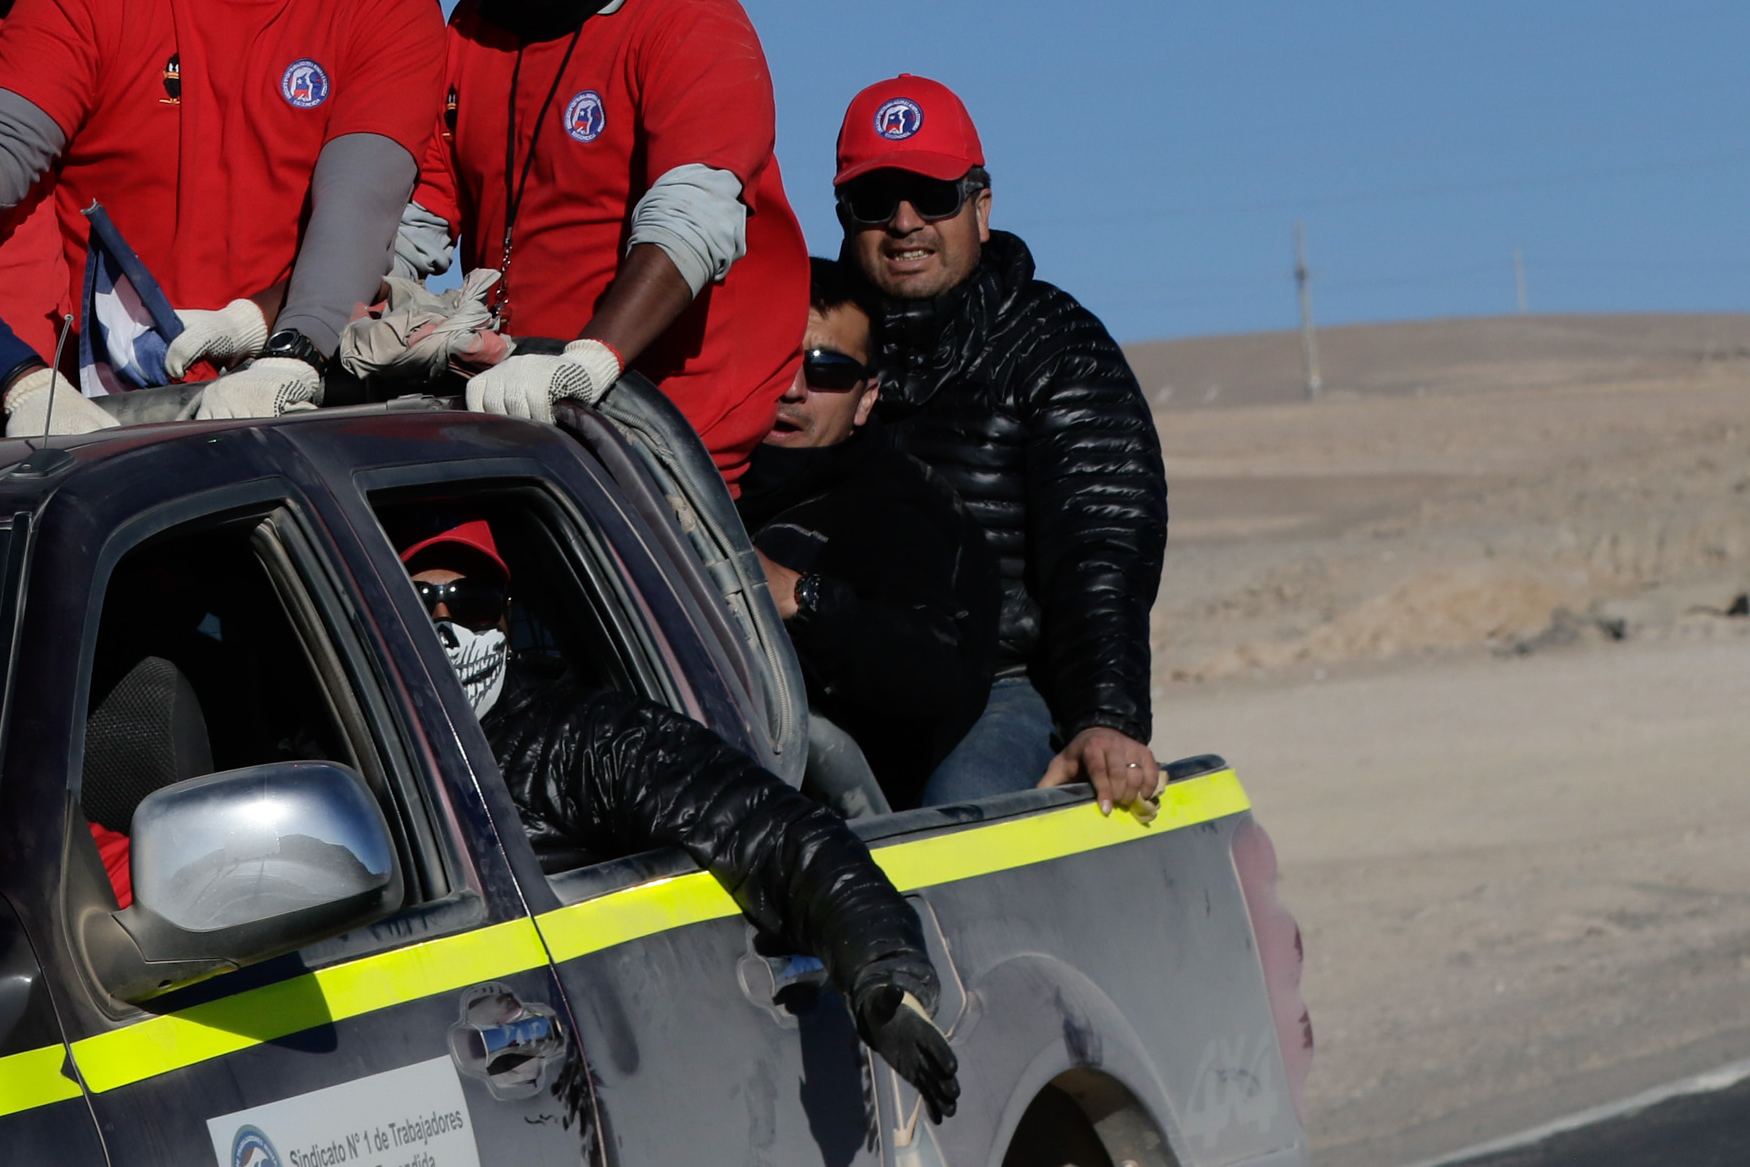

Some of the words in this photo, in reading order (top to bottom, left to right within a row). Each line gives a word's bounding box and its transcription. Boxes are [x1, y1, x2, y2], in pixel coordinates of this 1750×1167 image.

[289, 1140, 347, 1167] Sindicato
[363, 1130, 372, 1155] 1
[373, 1127, 390, 1152] de
[388, 1110, 464, 1146] Trabajadores
